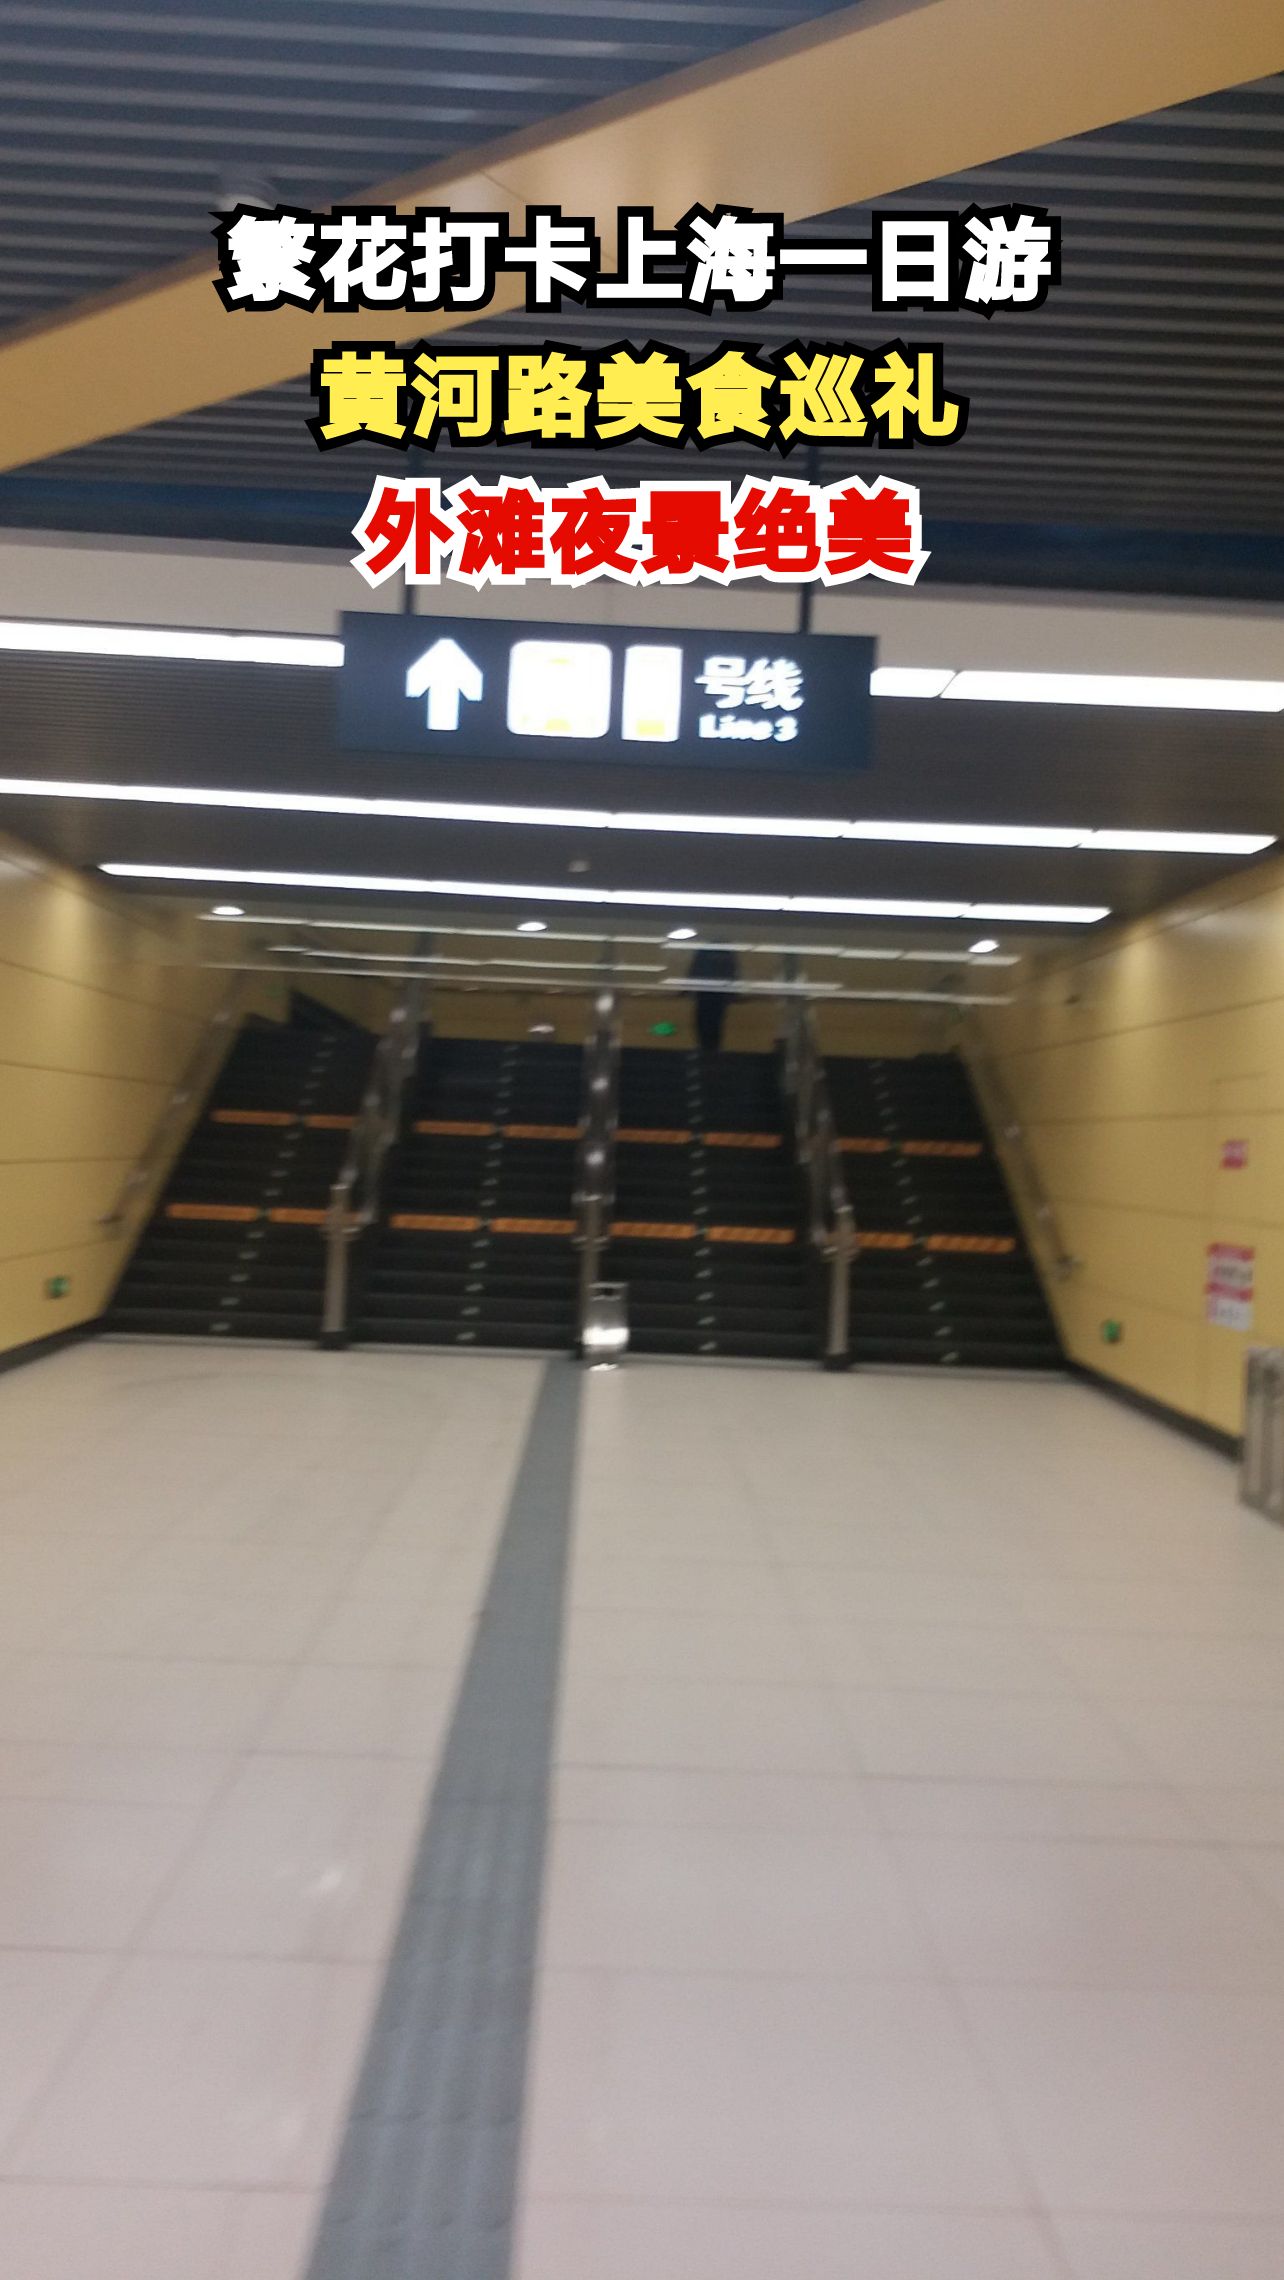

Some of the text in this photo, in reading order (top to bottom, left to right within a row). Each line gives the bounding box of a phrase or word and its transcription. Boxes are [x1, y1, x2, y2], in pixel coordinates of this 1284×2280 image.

[694, 655, 805, 712] 号线
[699, 713, 799, 742] Line 3
